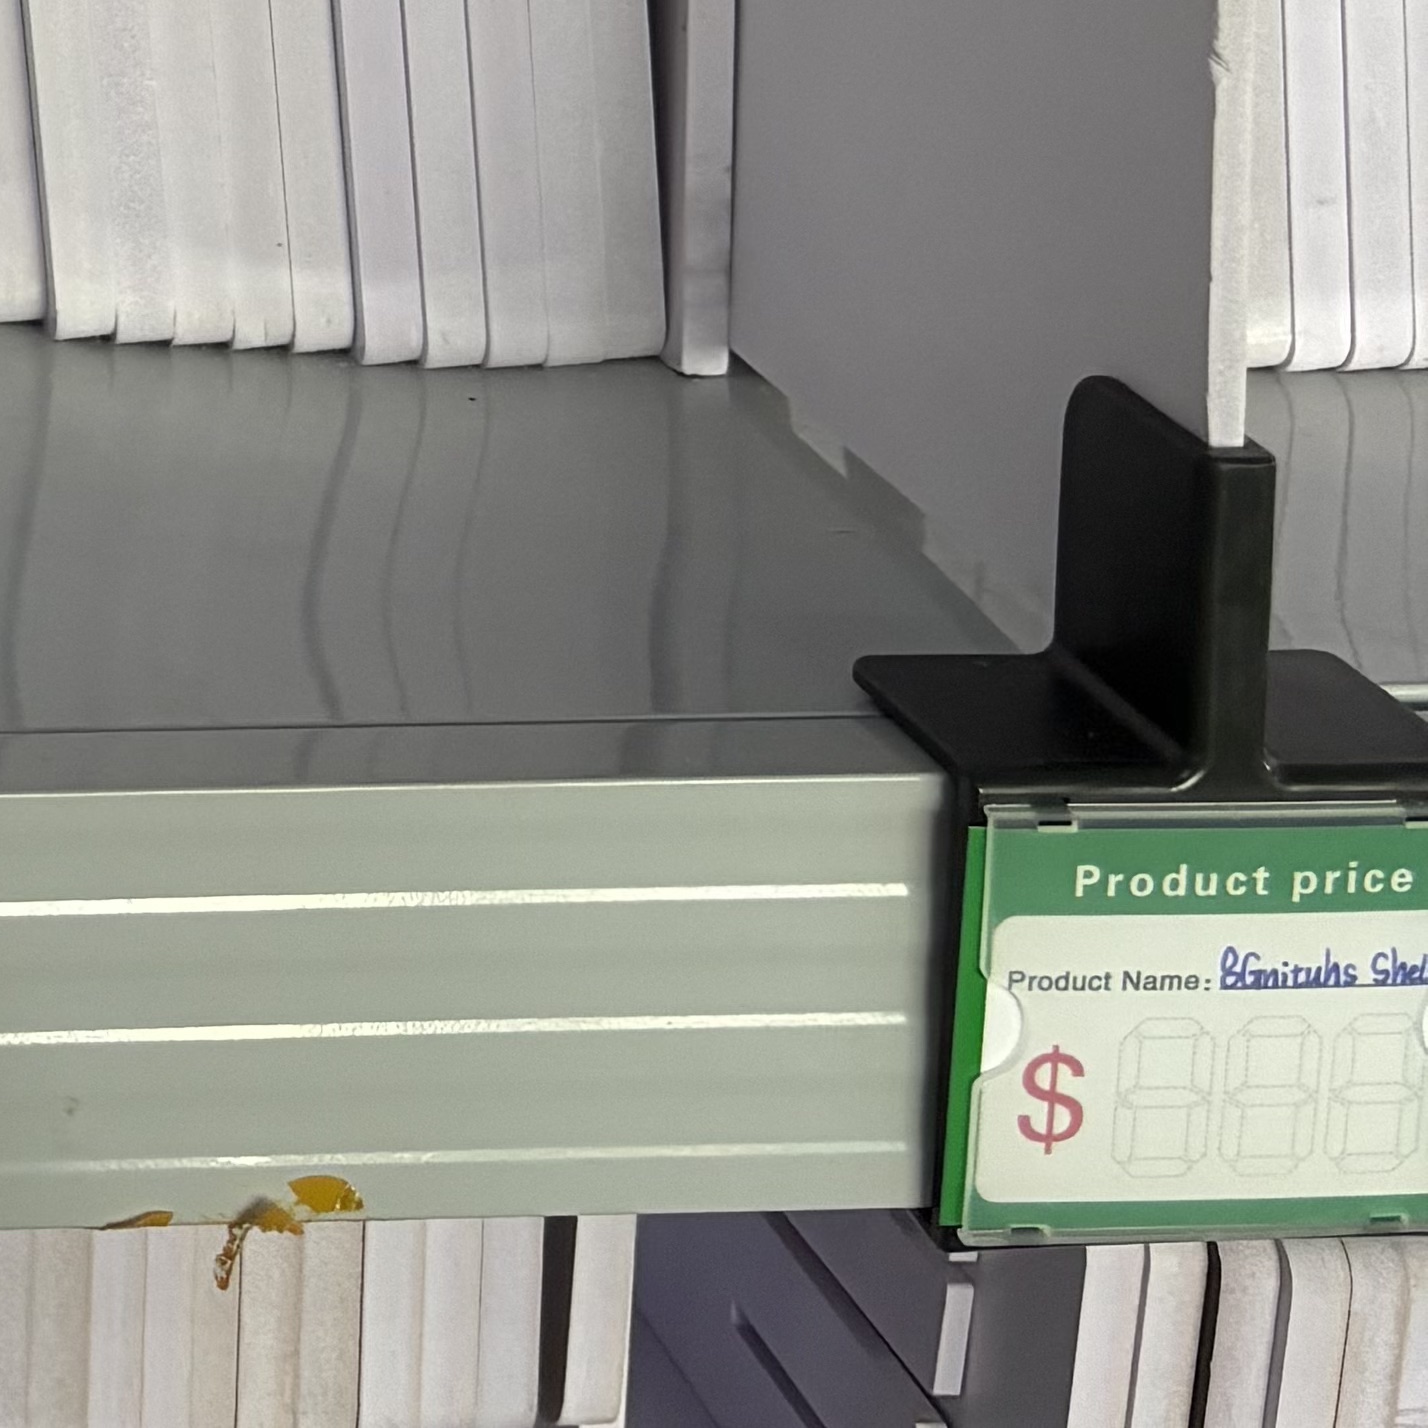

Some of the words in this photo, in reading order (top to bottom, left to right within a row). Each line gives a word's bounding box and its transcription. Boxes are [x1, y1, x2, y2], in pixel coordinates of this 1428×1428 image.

[1074, 863, 1270, 897] Product
[1292, 861, 1415, 903] price
[1007, 970, 1113, 992] Product
[1121, 971, 1212, 992] Name:
[1017, 1044, 1086, 1156] $
